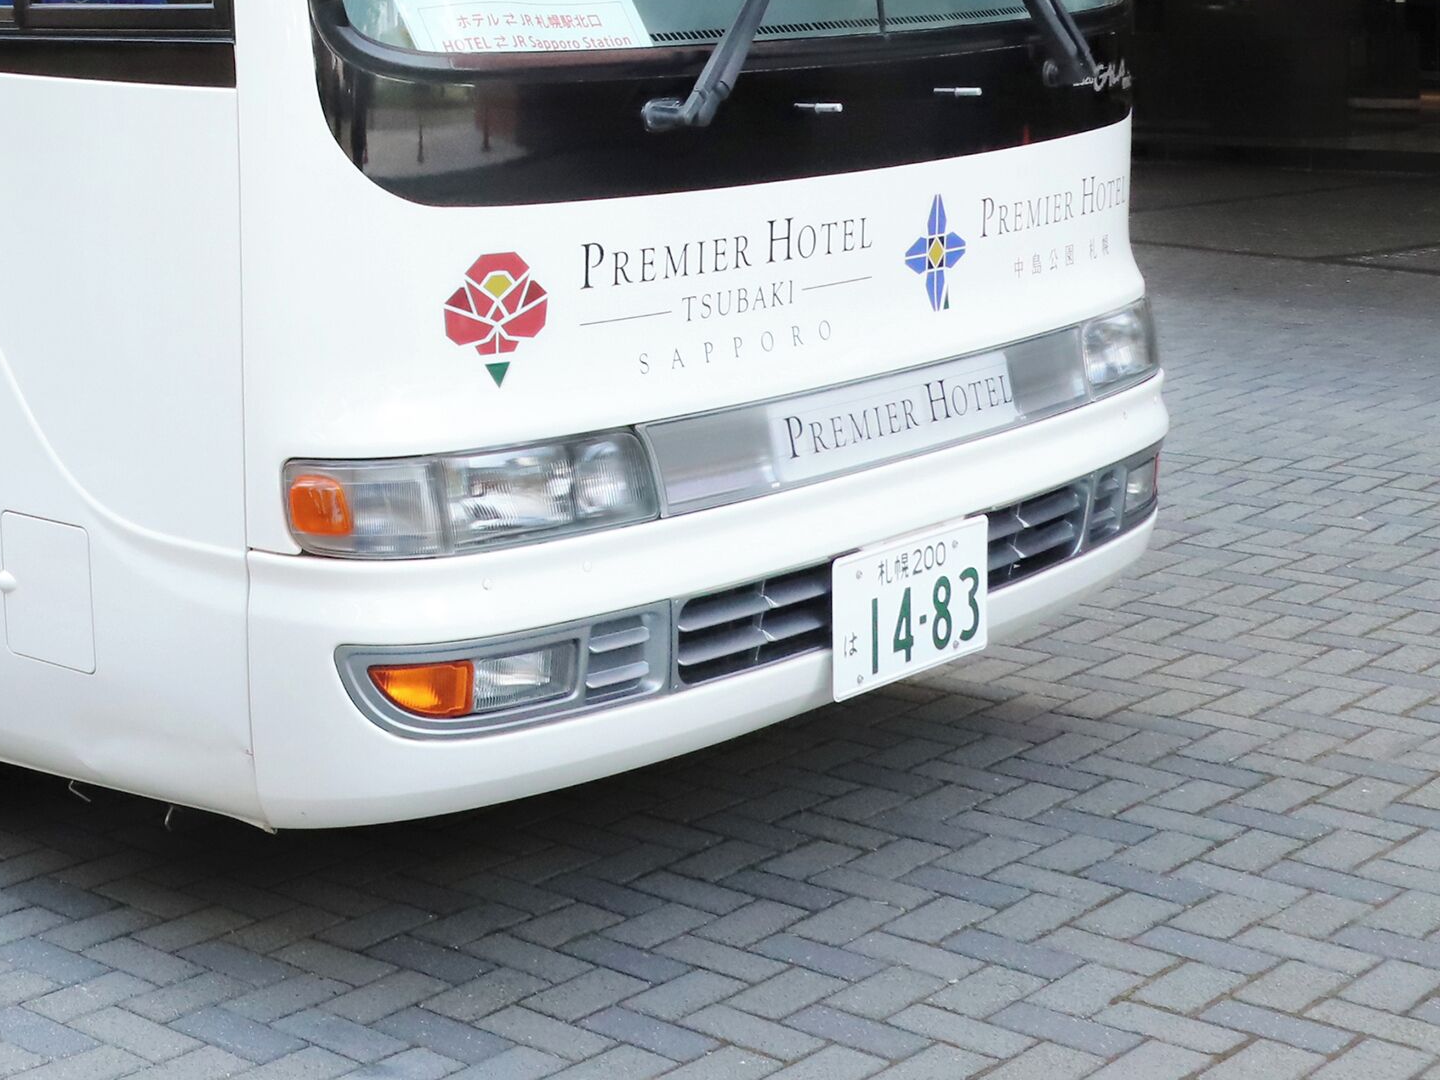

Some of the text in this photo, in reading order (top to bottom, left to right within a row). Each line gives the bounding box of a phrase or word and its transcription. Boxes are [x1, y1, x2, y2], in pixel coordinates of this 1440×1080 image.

[442, 35, 632, 53] HOTEL JR Sapporo Station
[457, 13, 500, 29] ホテル
[980, 176, 1126, 238] PREMIER HOTEL
[580, 217, 873, 289] PREMIER HOTEL
[1014, 244, 1074, 278] 中島公園
[681, 280, 794, 322] TSUBAKI
[638, 320, 832, 375] SAPPORO
[783, 375, 1013, 459] PREMIER HOTEL
[843, 566, 980, 675] は 14-83
